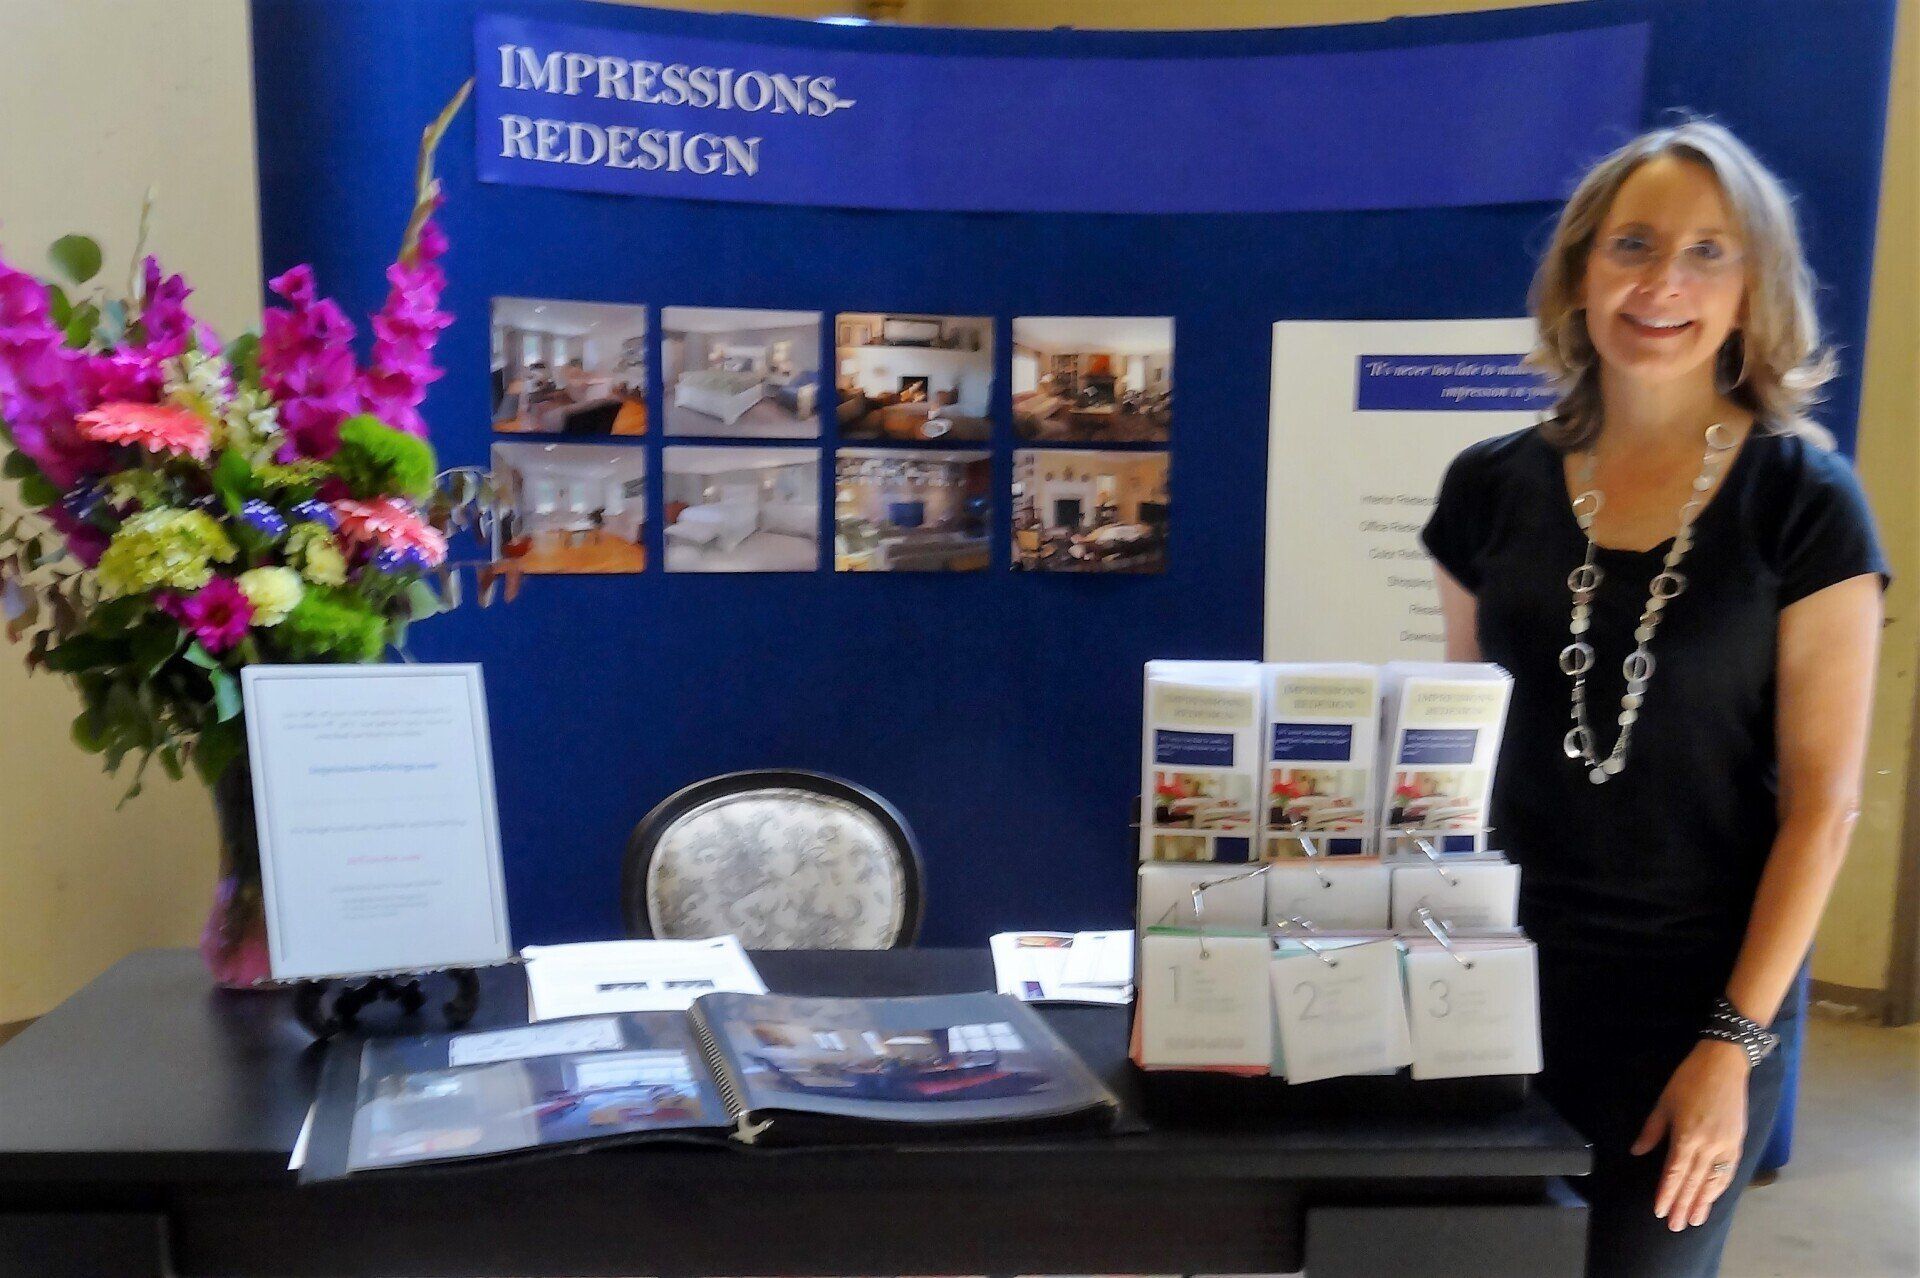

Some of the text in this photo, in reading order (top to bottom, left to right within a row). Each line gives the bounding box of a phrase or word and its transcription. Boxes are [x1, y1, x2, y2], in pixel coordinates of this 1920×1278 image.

[498, 114, 763, 177] REDESIGN
[1393, 365, 1431, 377] never
[1441, 385, 1508, 402] impression
[1168, 965, 1180, 1003] 1
[1293, 980, 1320, 1021] 2
[1428, 979, 1450, 1020] 3
